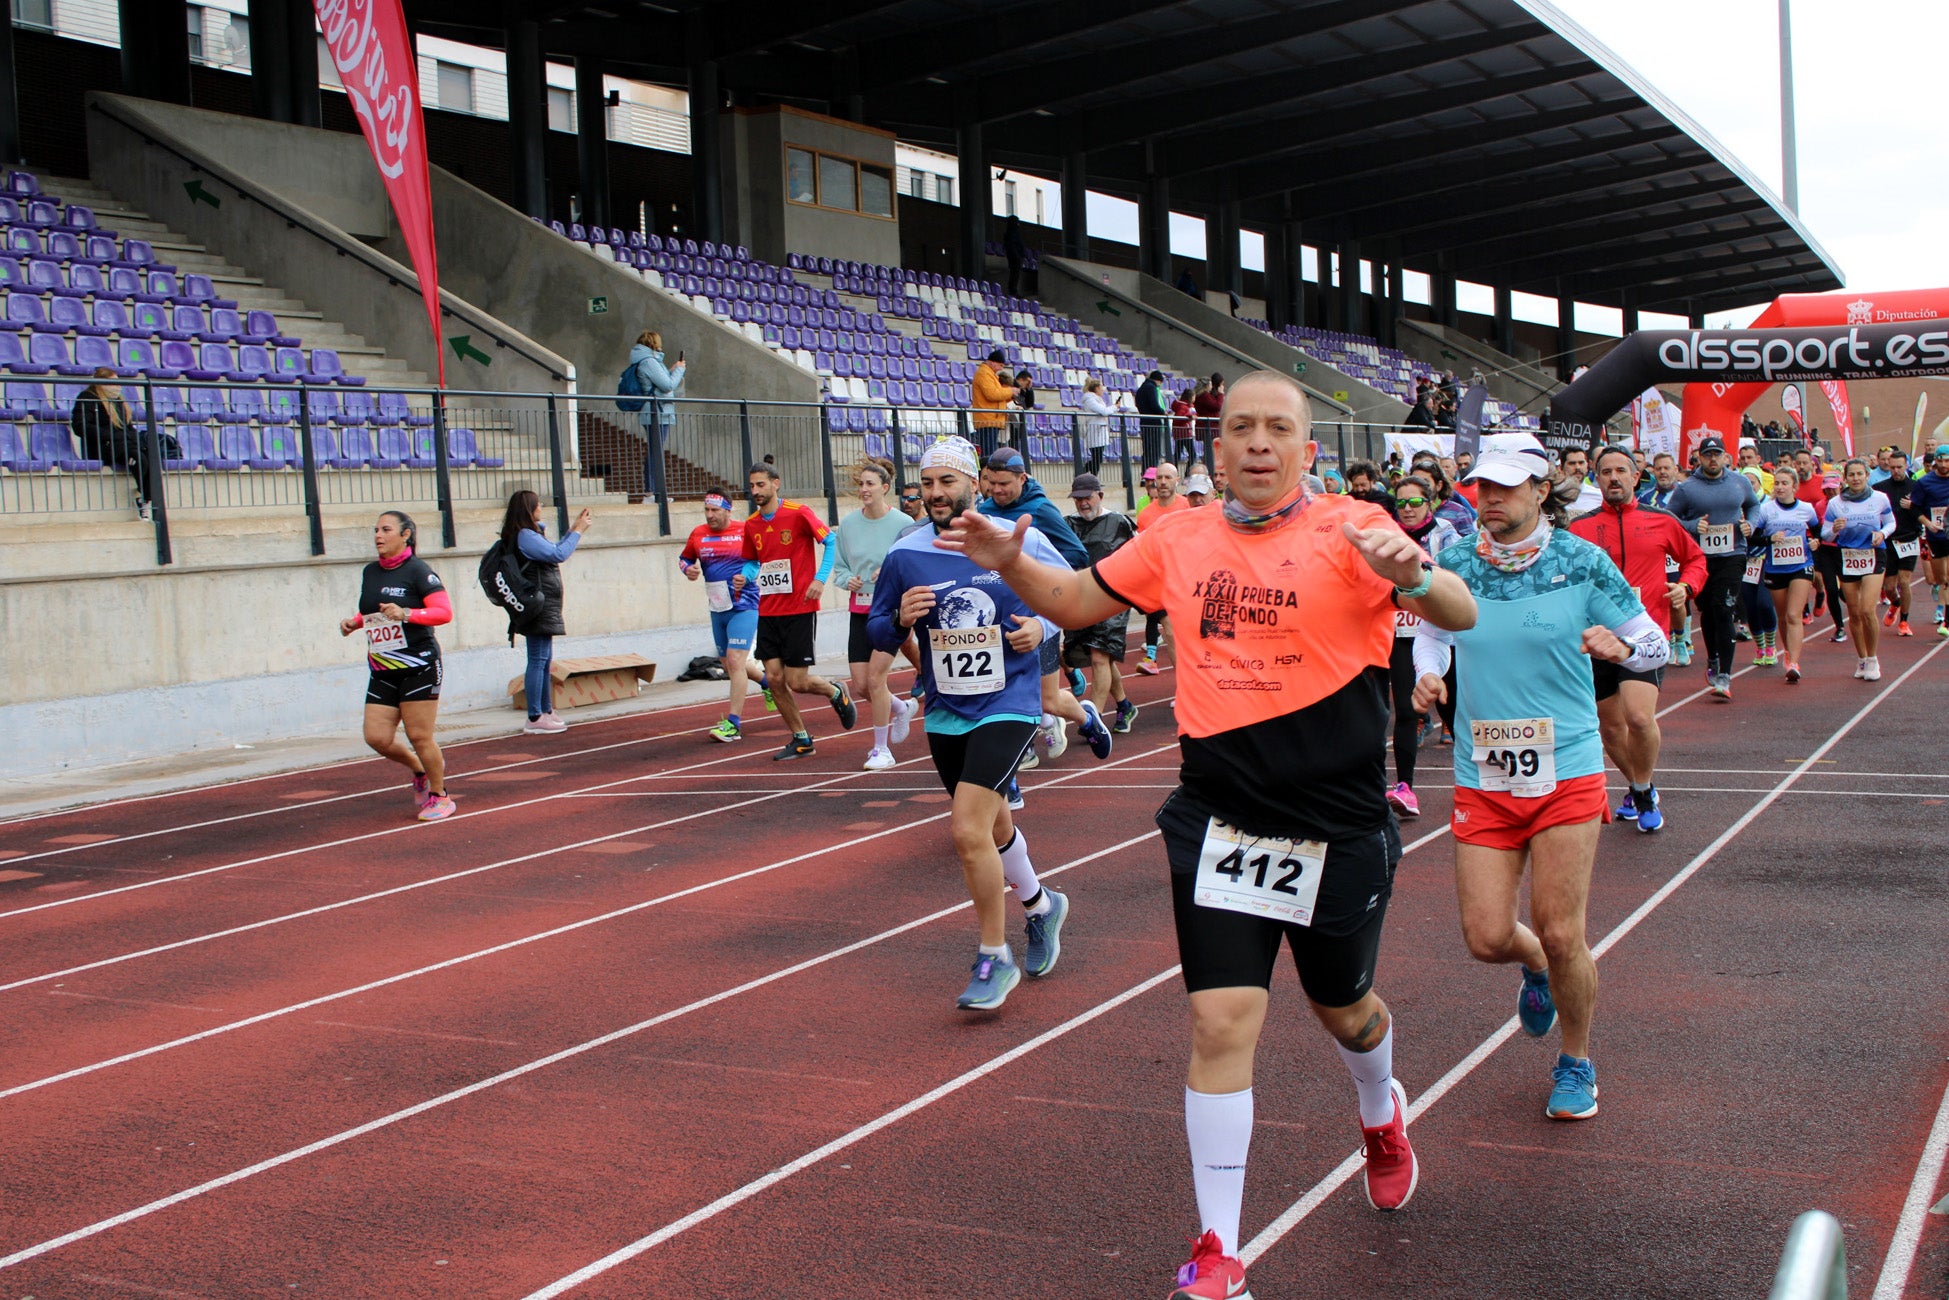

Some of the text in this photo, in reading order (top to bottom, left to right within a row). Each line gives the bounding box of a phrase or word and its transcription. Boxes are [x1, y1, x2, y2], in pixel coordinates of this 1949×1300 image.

[1876, 307, 1938, 322] Diputación
[1658, 327, 1949, 382] alssport.es
[1721, 373, 1764, 383] TIENDA
[1776, 372, 1834, 382] RUNNING
[1843, 371, 1881, 380] TRAIL
[754, 533, 763, 551] 3
[1705, 535, 1729, 547] 101
[1900, 541, 1917, 553] 817
[1773, 546, 1803, 558] 2080
[1845, 558, 1873, 569] 2081
[760, 573, 789, 587] 3054
[494, 571, 525, 612] adidas
[1192, 581, 1298, 609] XXXII PRUEBA
[1205, 602, 1278, 627] DE FONDO
[942, 632, 986, 645] FONDO
[942, 651, 993, 678] 122
[1275, 653, 1303, 665] HSN
[1217, 679, 1282, 691] datacol.com
[1485, 726, 1535, 740] FONDO
[1215, 848, 1304, 896] 412
